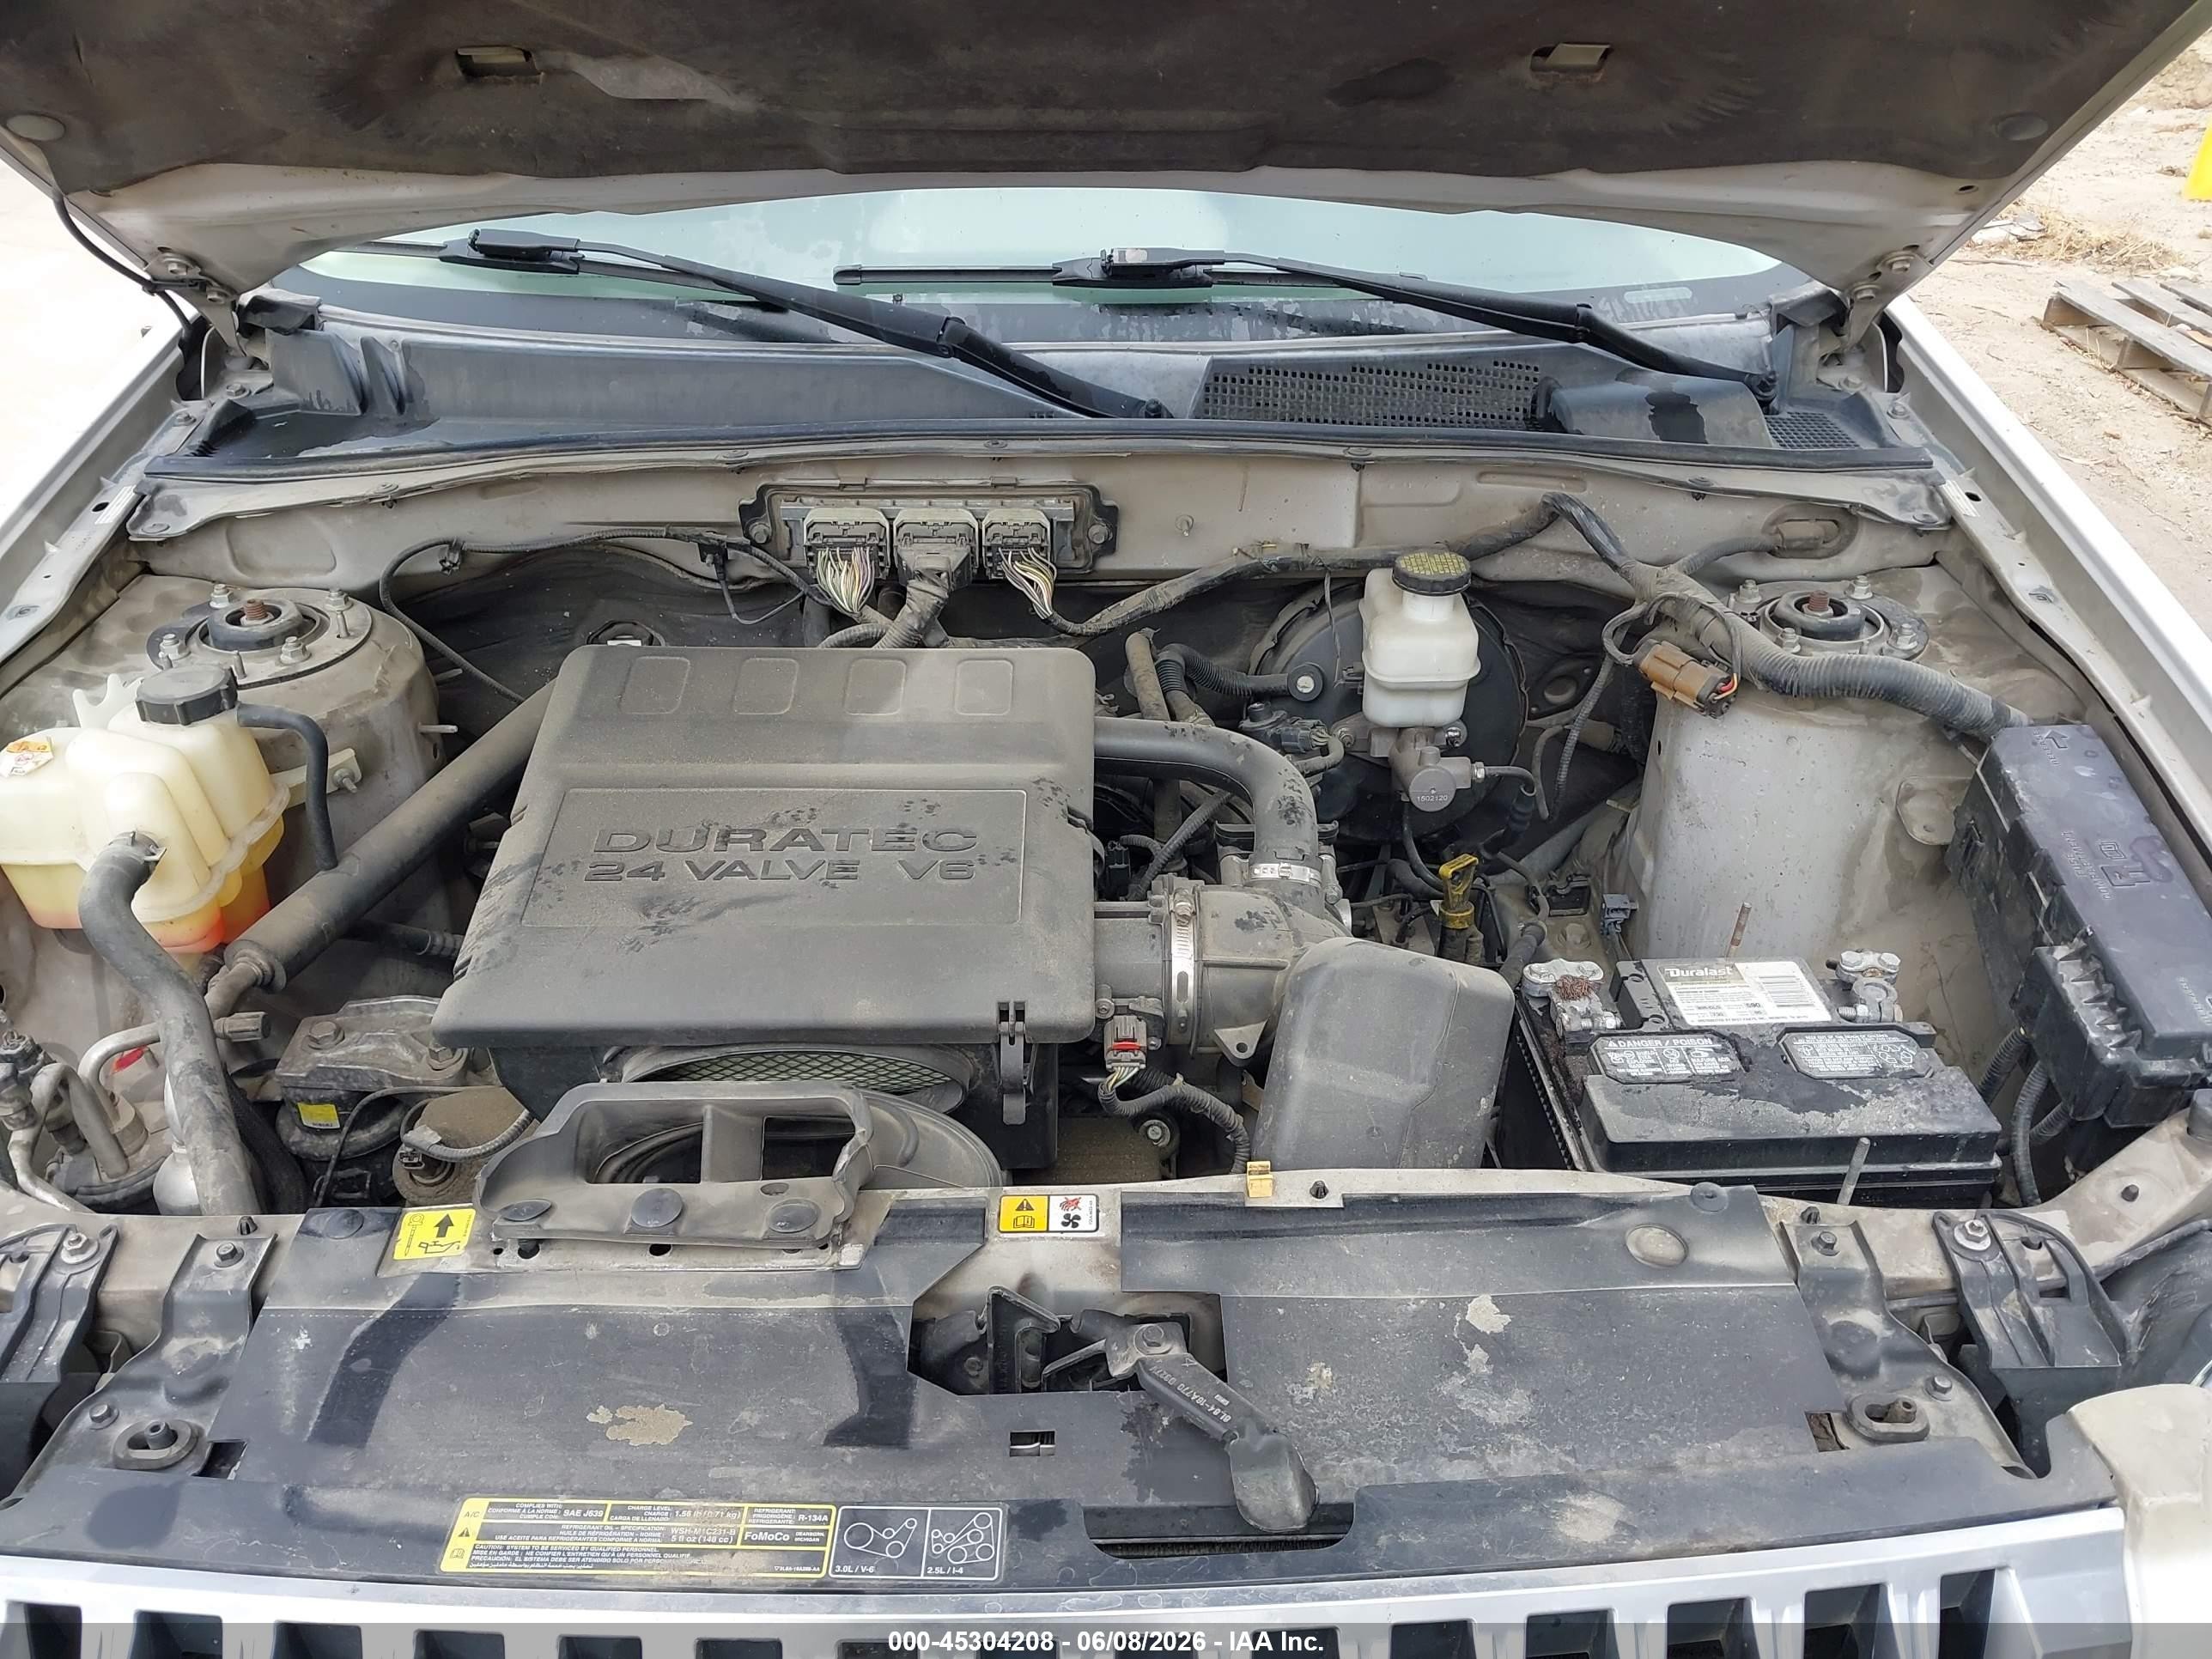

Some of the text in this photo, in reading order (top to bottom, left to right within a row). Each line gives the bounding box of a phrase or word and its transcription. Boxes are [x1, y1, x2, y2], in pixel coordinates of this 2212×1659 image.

[593, 828, 978, 853] DURATEC
[585, 860, 977, 882] 24 VALVE V6
[1664, 965, 1735, 978] Duralast
[726, 1510, 741, 1520] kg)
[719, 1535, 733, 1544] cc)
[744, 1531, 790, 1541] FoMoCo
